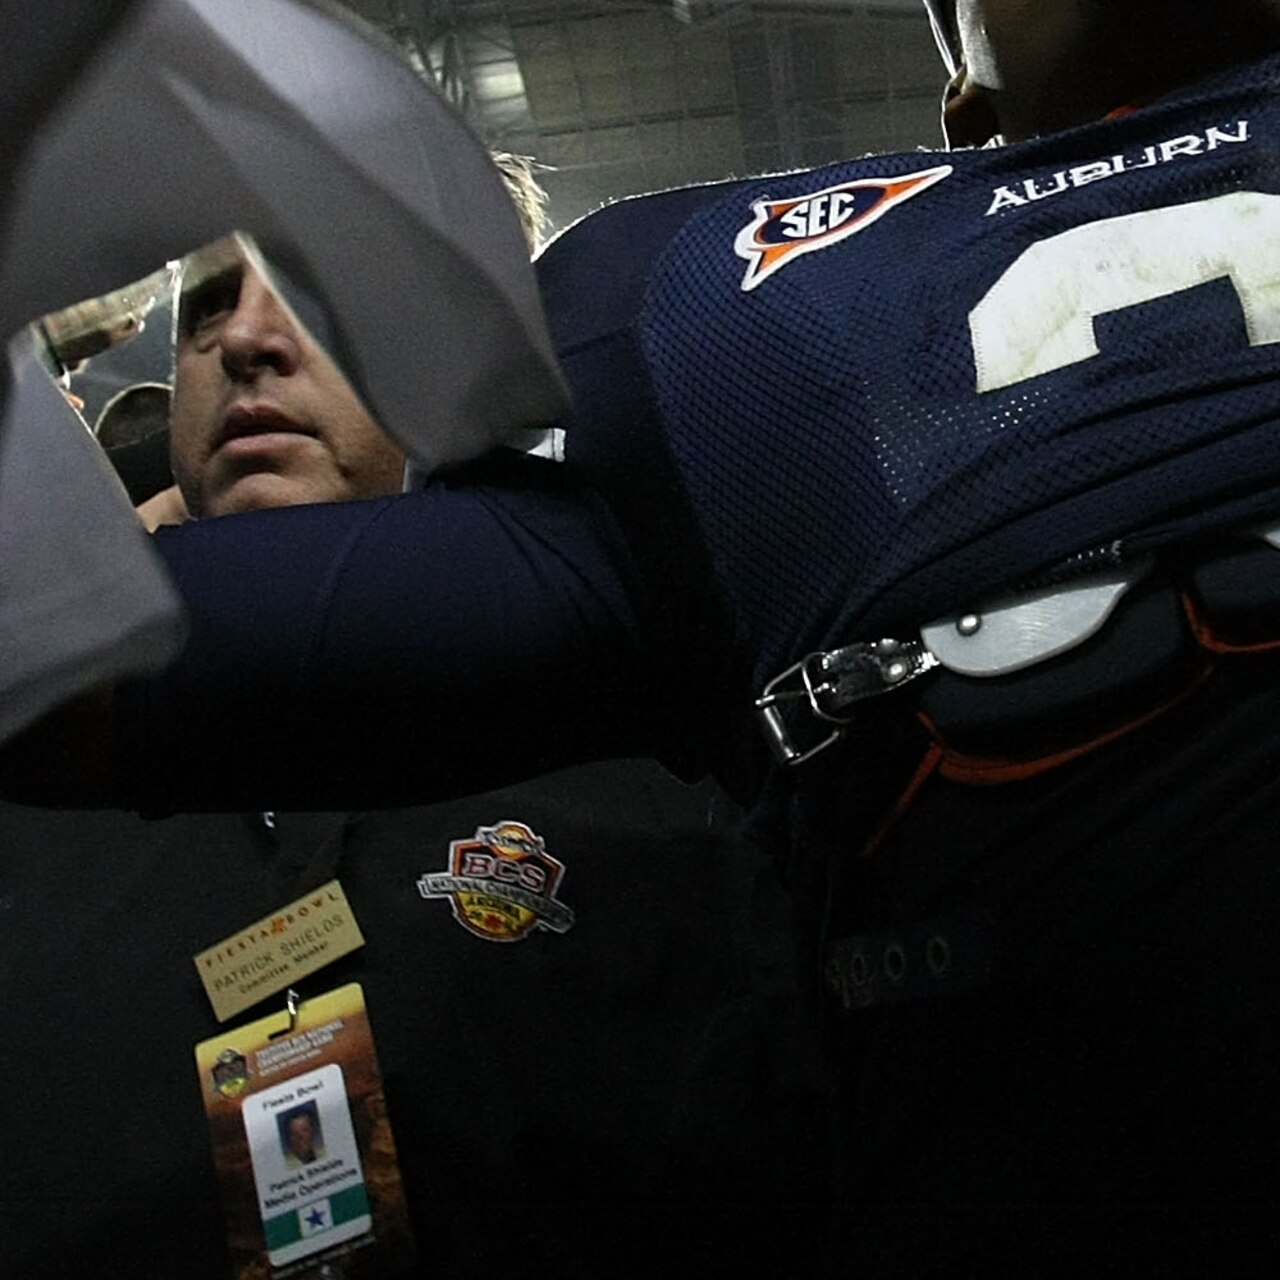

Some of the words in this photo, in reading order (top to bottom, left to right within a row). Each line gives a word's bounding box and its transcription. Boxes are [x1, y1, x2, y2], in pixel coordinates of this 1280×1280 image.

[985, 120, 1249, 217] AUBURN
[779, 192, 856, 239] SEC
[461, 853, 546, 893] BCS
[205, 929, 269, 968] FIESTA
[286, 891, 339, 924] BOWL
[214, 951, 275, 991] PATRICK
[279, 913, 344, 956] SHIELDS
